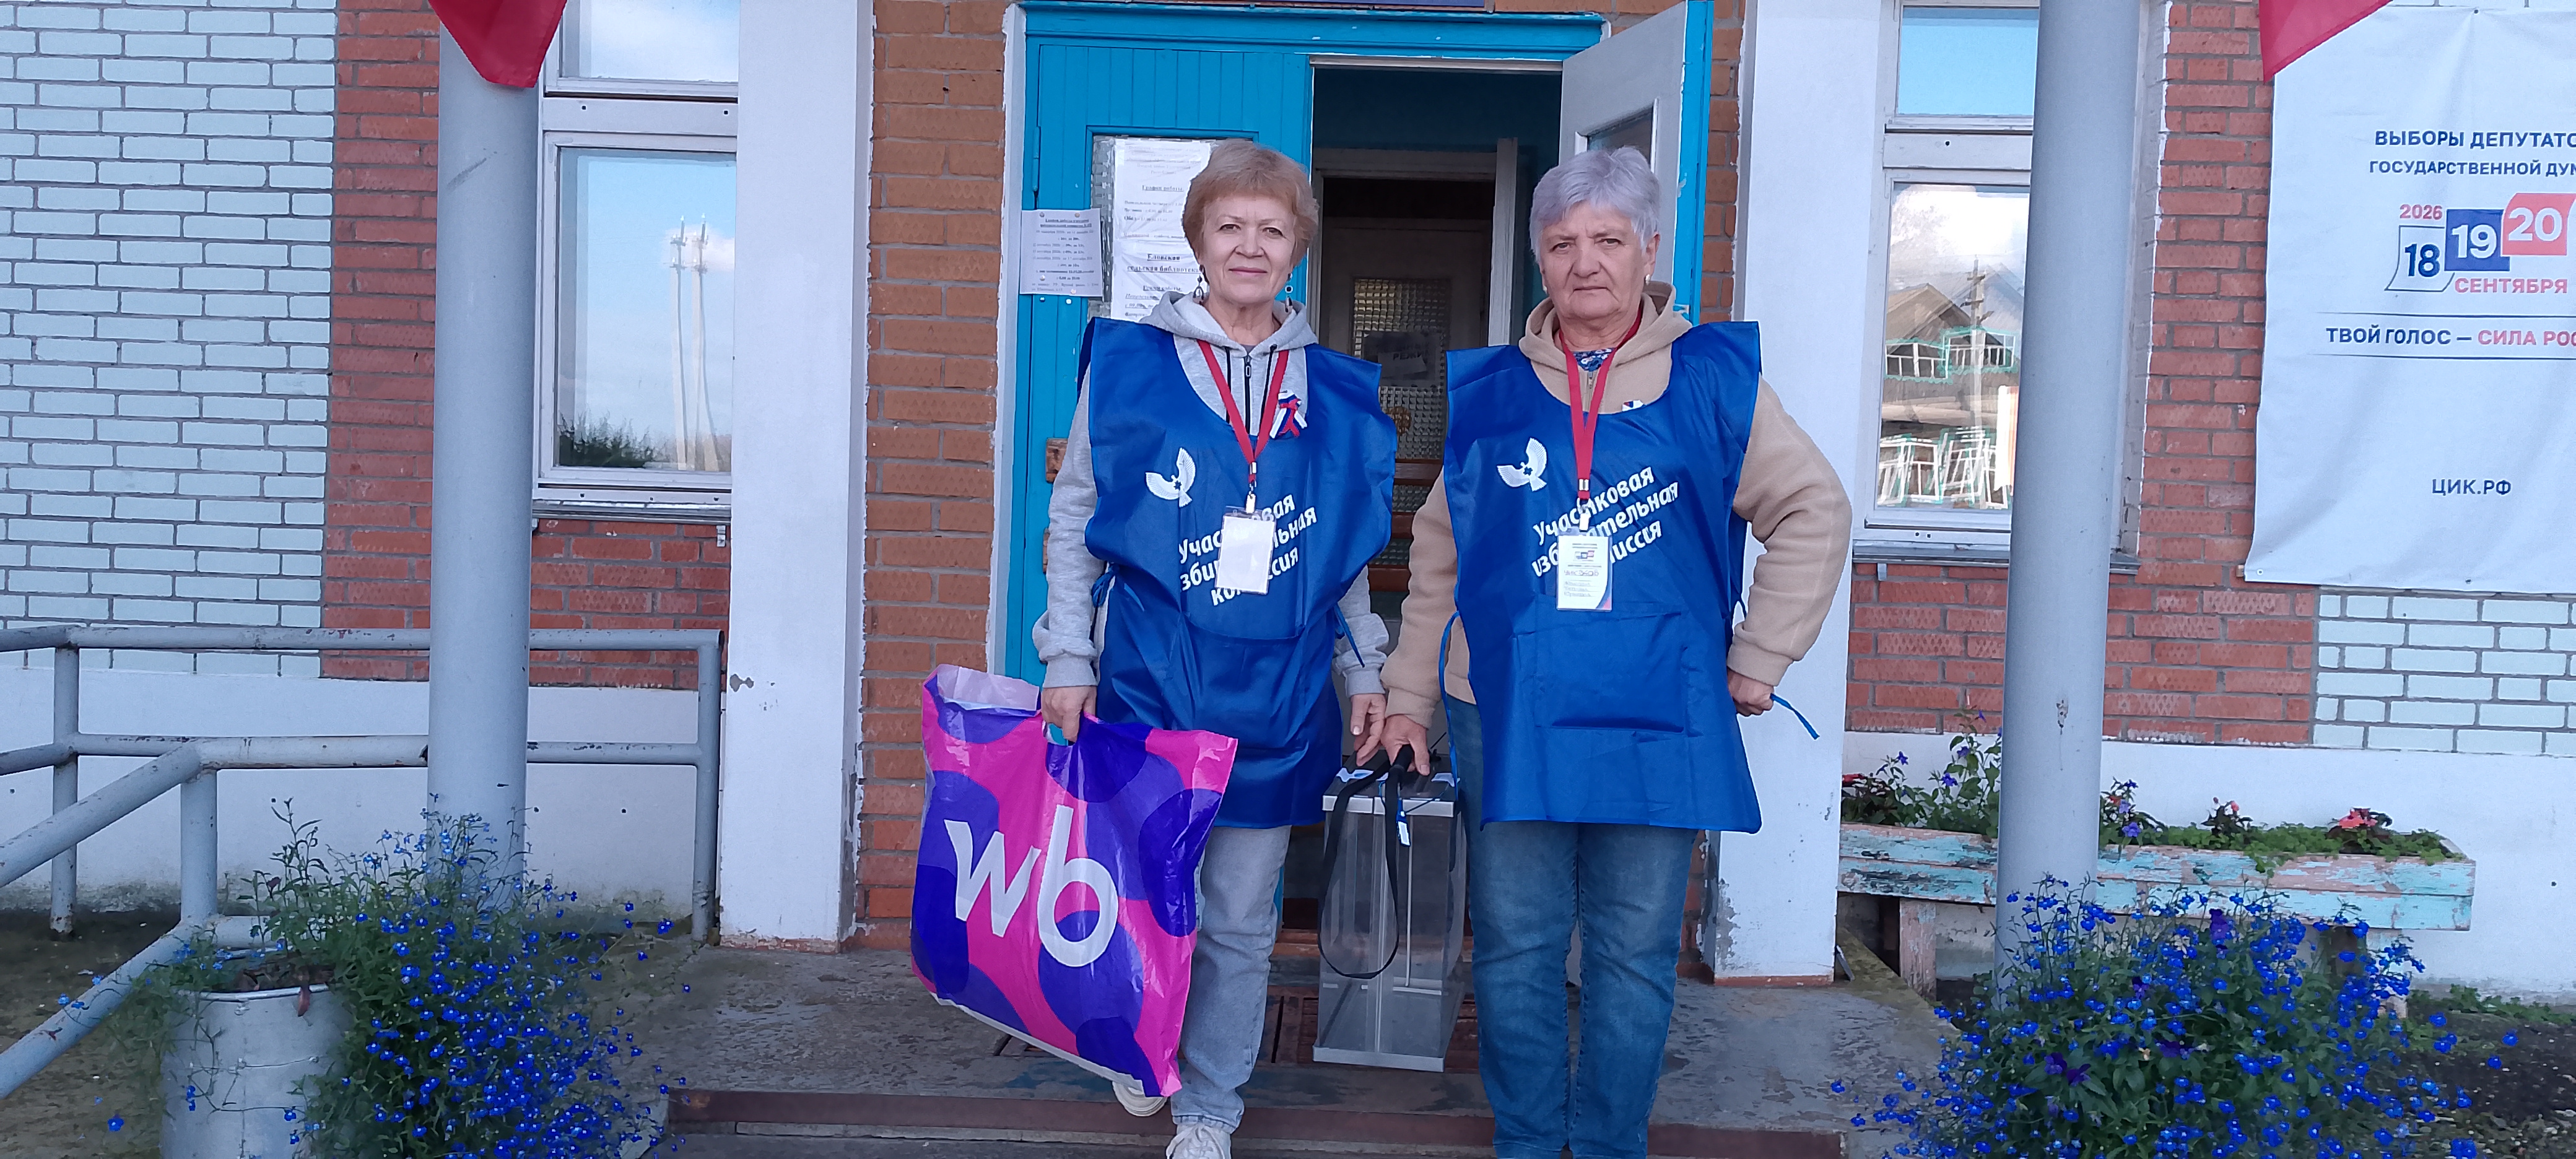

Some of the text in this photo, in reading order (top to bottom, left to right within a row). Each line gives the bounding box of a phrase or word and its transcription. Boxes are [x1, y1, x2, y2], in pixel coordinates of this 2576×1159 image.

[2375, 130, 2465, 147] ВЫБОРЫ
[2370, 159, 2541, 175] ГОСУДАРСТВЕННОЙ
[2400, 204, 2443, 220] 2026
[2404, 207, 2562, 277] 18 19 20
[2454, 278, 2568, 294] СЕНТЯБРЯ
[2326, 324, 2381, 344] ТВОЙ
[2385, 329, 2452, 345] ГОЛОС
[2478, 330, 2537, 345] СИЛА
[2432, 479, 2512, 496] ЦИК.РФ
[1178, 494, 1295, 564] Учасвая
[1211, 547, 1299, 606] косия
[944, 804, 1119, 967] wb
